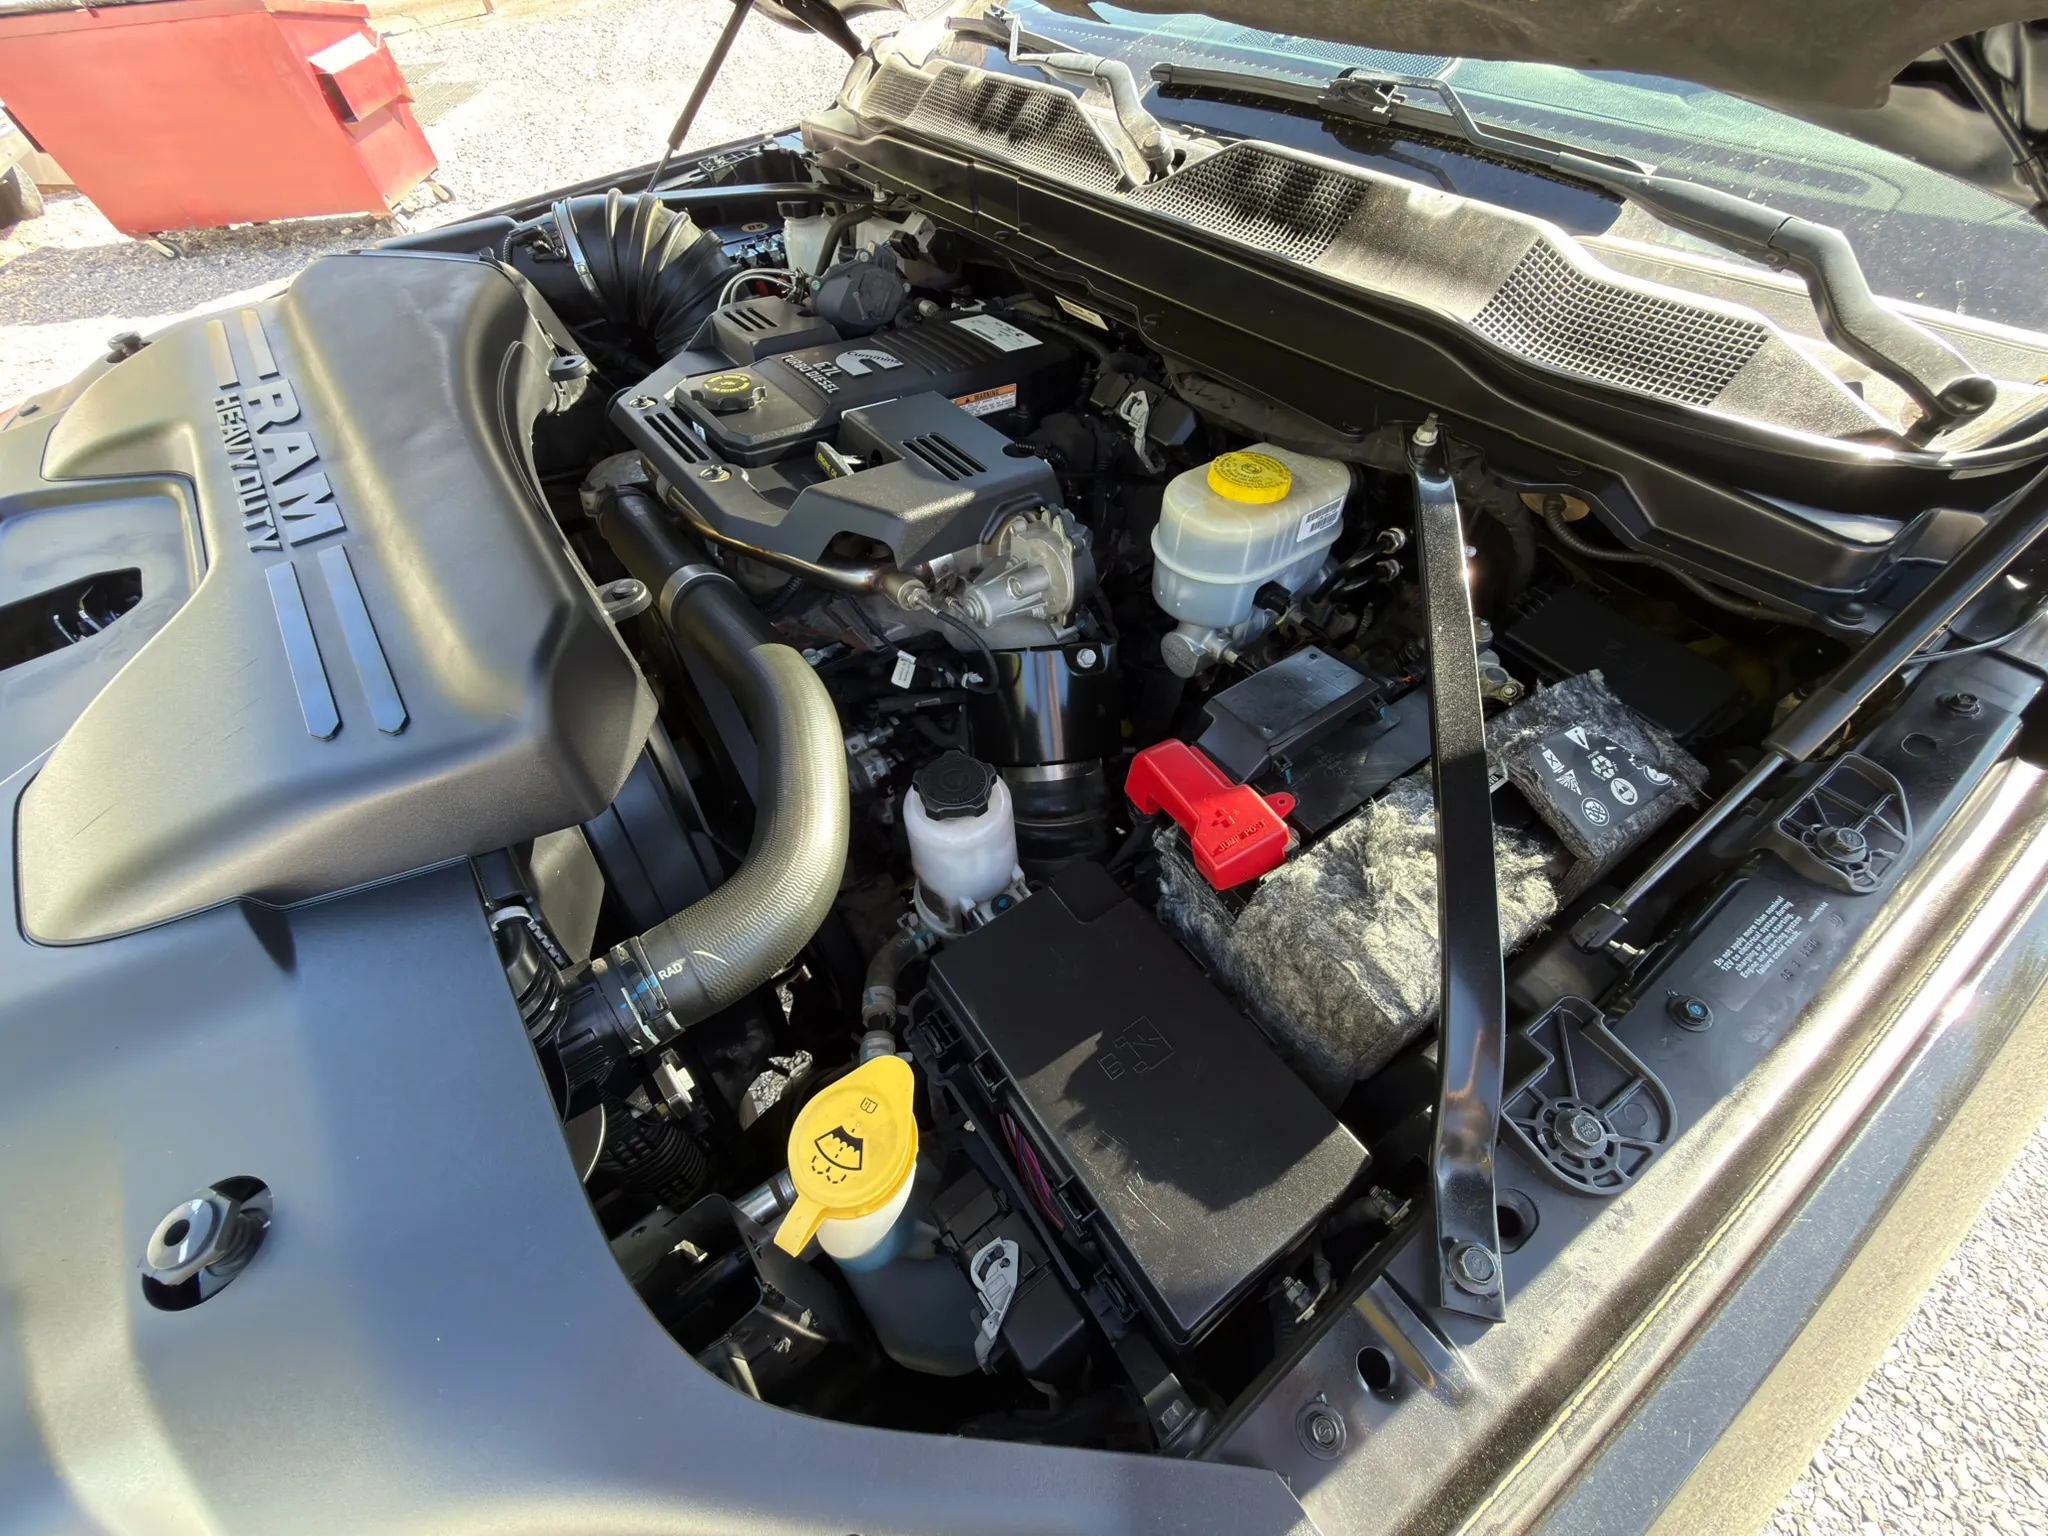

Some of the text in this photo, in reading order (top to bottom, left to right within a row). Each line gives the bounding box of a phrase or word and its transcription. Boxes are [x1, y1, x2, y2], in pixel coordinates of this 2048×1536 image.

[781, 354, 840, 394] TURBO DIESEL
[812, 361, 842, 377] 6.7L
[213, 393, 283, 552] HEAVY DUTY
[245, 378, 346, 547] RAM
[1217, 819, 1267, 853] JUMP POST
[658, 962, 683, 980] RAD
[1713, 957, 1725, 967] Do
[1720, 958, 1735, 972] 12V
